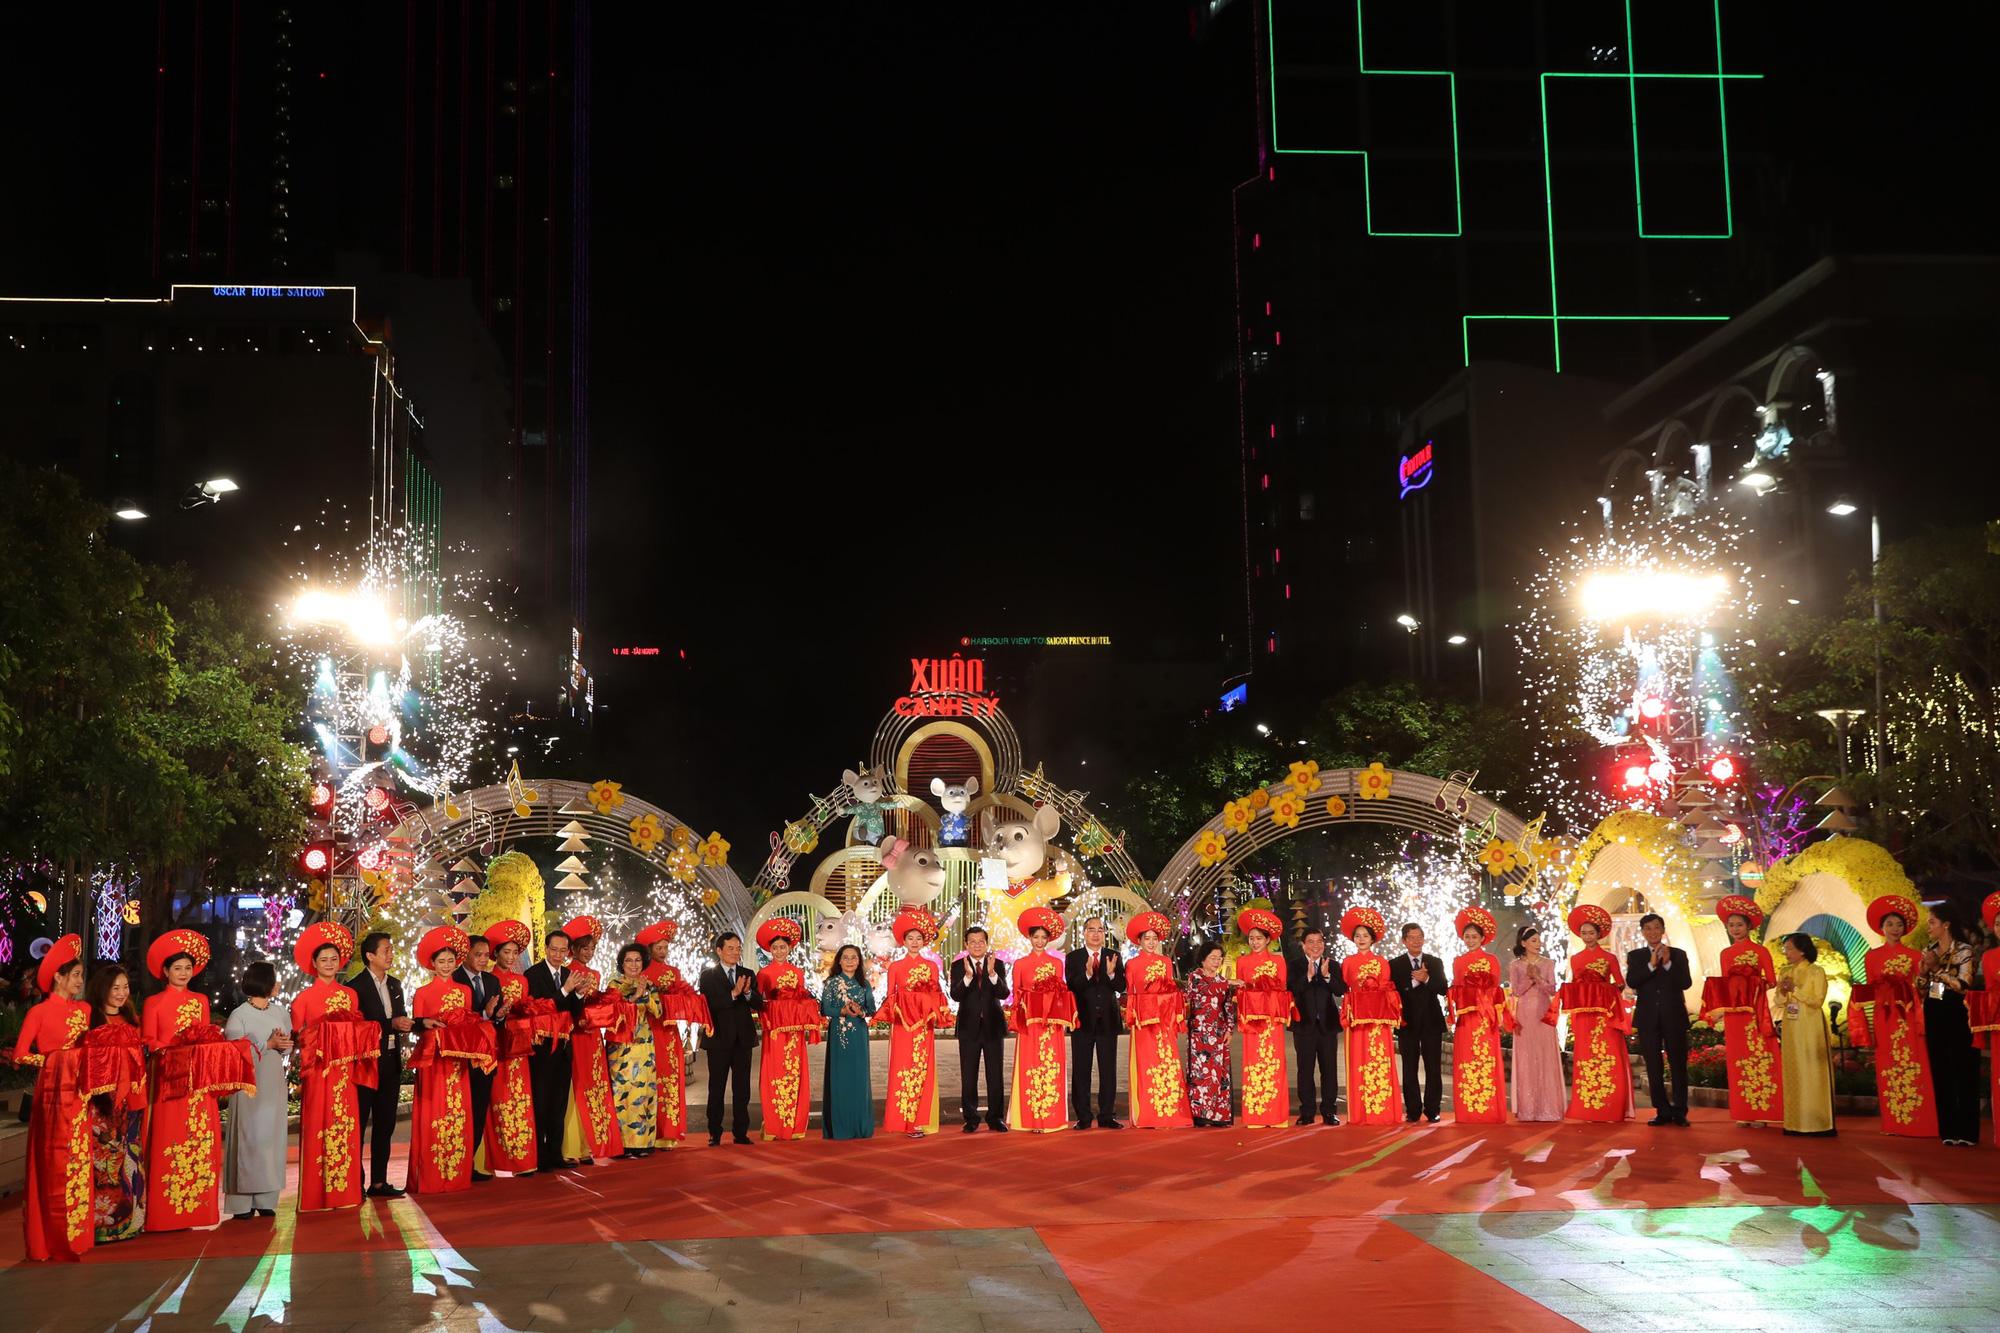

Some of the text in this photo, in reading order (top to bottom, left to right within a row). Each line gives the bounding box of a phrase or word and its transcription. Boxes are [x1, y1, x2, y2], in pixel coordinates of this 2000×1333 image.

[213, 286, 325, 298] OSCAR HOTEL SAIGON
[970, 637, 1009, 645] HARBOUR
[1011, 637, 1031, 645] VIEW
[1046, 636, 1111, 645] SAIGON PRINCE HOTEL
[910, 653, 984, 693] XUÂN
[894, 691, 1000, 717] CANH TÝ
